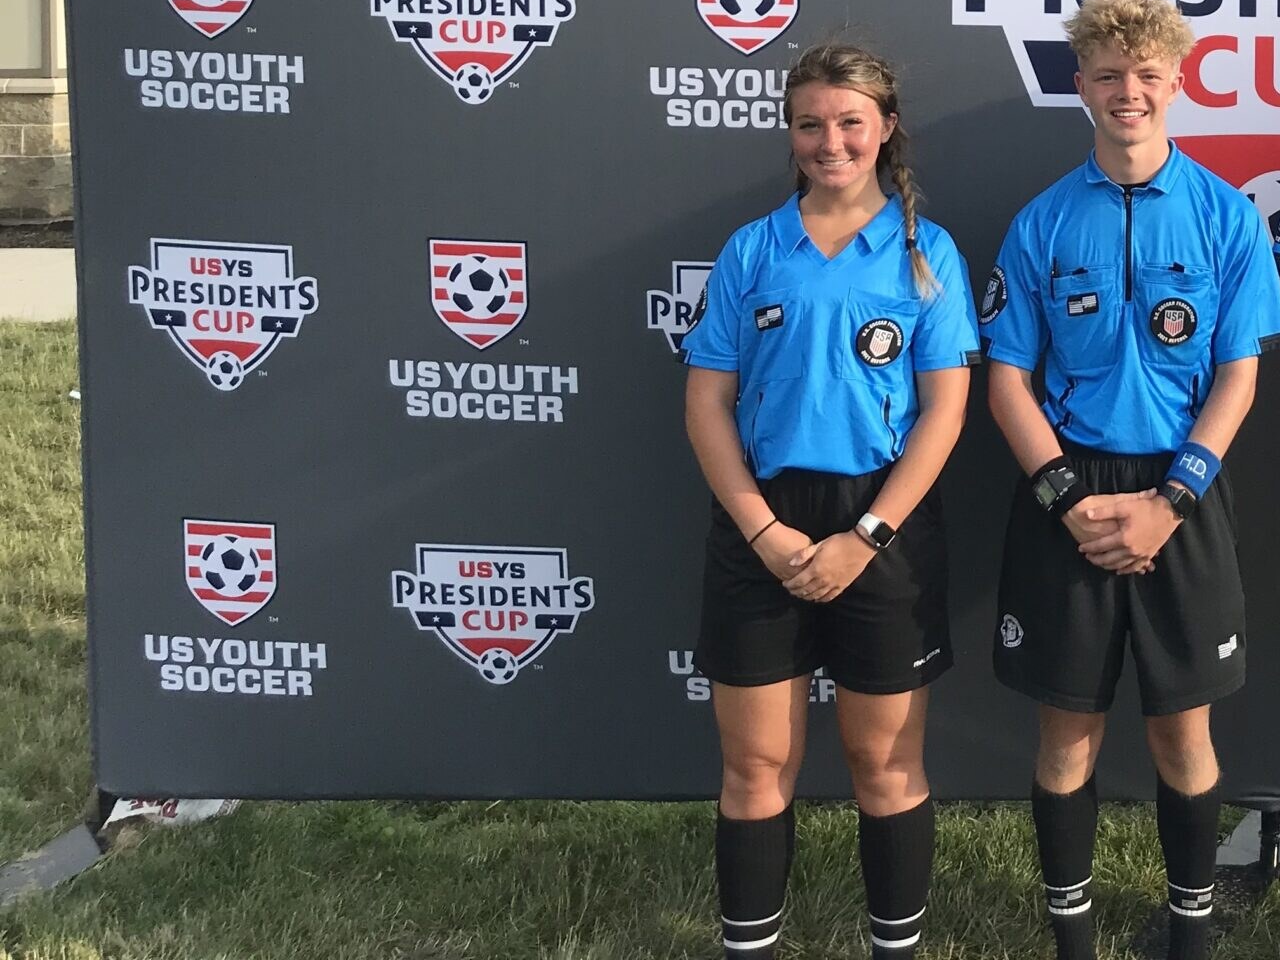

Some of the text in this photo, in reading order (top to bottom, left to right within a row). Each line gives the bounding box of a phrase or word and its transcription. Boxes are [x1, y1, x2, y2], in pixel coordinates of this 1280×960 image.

[440, 20, 506, 43] CUP
[141, 80, 289, 113] SOCCER
[191, 258, 252, 277] USYS
[132, 270, 314, 310] PRESIDENTS
[193, 310, 254, 333] CUP
[1166, 311, 1183, 321] USA
[875, 330, 892, 342] USA
[407, 390, 563, 422] SOCCER
[1178, 452, 1207, 479] H.D.
[459, 561, 525, 579] USYS
[396, 575, 591, 608] PRESIDENTS
[462, 610, 528, 631] CUP
[161, 665, 312, 695] SOCCER
